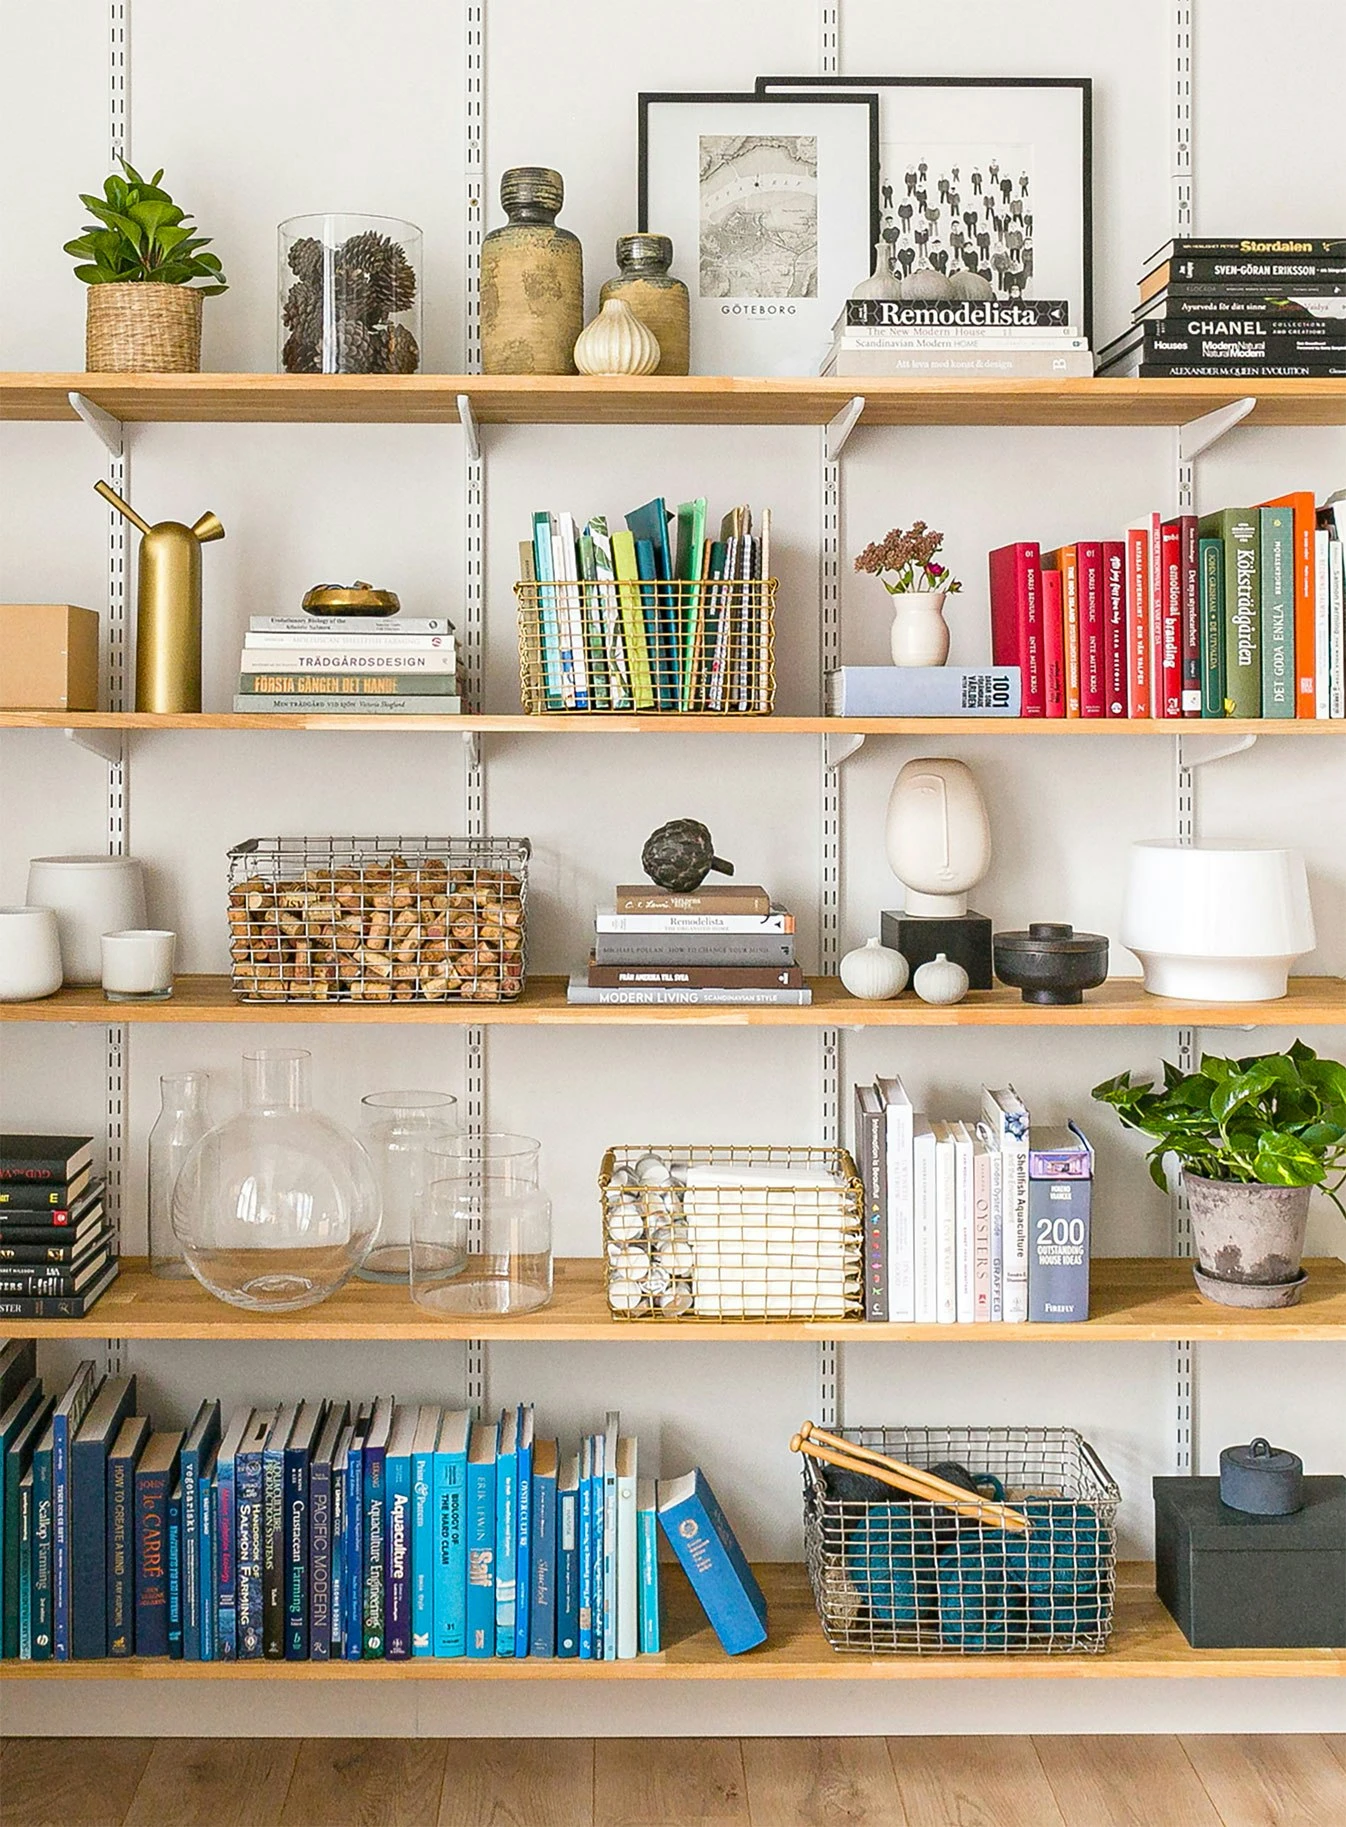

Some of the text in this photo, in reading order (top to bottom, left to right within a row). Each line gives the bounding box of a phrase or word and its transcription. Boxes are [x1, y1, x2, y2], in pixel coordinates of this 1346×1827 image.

[1240, 240, 1312, 253] Stordalen
[1214, 263, 1271, 275] SVEN-GÖRAN
[1273, 264, 1316, 275] ERIKSSON
[721, 303, 797, 315] GÖTEBORG
[880, 301, 1038, 326] Remodelista
[1181, 303, 1219, 312] Ayurveda
[1220, 302, 1232, 310] för
[867, 327, 987, 337] The New Modern House
[1187, 321, 1267, 335] CHANEL
[855, 339, 914, 349] Scandinavian
[916, 339, 952, 349] Modern
[1154, 340, 1188, 350] Houses
[896, 360, 911, 369] Att
[983, 360, 1013, 372] design
[1169, 366, 1310, 376] ALEXANDER EVOLUTION
[1188, 569, 1197, 583] Det
[1208, 554, 1216, 576] JOHN
[1187, 584, 1196, 597] nya
[1332, 570, 1342, 635] Salmon Farming
[1163, 564, 1180, 669] emotional branding
[1231, 548, 1257, 667] Köksträdgården
[1272, 603, 1284, 641] ENKLA
[1209, 621, 1217, 633] DE
[1029, 636, 1037, 654] INTE
[1209, 633, 1217, 671] UTVALDA
[298, 655, 426, 667] TRÄDGÅRDSDESIGN
[1090, 654, 1098, 674] MITT
[1273, 645, 1285, 676] GODA
[254, 675, 359, 694] FÖRSTA GÅNGEN DET
[993, 675, 1010, 708] 1001
[1030, 675, 1038, 695] KRIG
[1090, 675, 1098, 694] KRIG
[1273, 680, 1285, 703] DET
[599, 992, 778, 1003] MODERN LIVING SCANDINAVIAN STYLE
[871, 1118, 881, 1199] Information Beautiful
[1016, 1153, 1027, 1196] Shellfish
[976, 1198, 989, 1280] OYSTERS
[992, 1157, 1001, 1313] London Oyster Guide GRAFFEG
[1014, 1198, 1026, 1258] Aquaculture
[1036, 1218, 1084, 1245] 200
[1036, 1245, 1084, 1255] OUTSTANDING
[1039, 1255, 1083, 1266] HOUSE IDEAS
[114, 1464, 124, 1488] HOW
[115, 1489, 124, 1503] TO
[142, 1493, 162, 1510] le
[185, 1463, 197, 1533] vegetariskt
[273, 1460, 282, 1532] AQUACULTURE
[414, 1460, 429, 1527] Print & Pattern
[114, 1504, 124, 1542] CREATE
[265, 1460, 274, 1571] PRODUCTION SYSTEMS
[451, 1493, 460, 1545] BIOLOGY OF
[476, 1476, 486, 1541] ERIK LEWIN
[520, 1480, 529, 1546] OYSTER CULTURE
[252, 1503, 261, 1578] HANDBOOK OF
[390, 1494, 409, 1579] Aquaculture
[441, 1493, 450, 1565] THE HARD CLAM
[35, 1501, 51, 1591] Scallop Farming
[142, 1512, 165, 1578] CARRÉ
[289, 1499, 305, 1613] Crustacean Farming
[366, 1462, 383, 1629] LEKANG Aquaculture Engineering
[115, 1550, 124, 1576] MIND
[221, 1553, 231, 1582] Ecology
[240, 1504, 252, 1626] SALMON FARMING
[313, 1494, 328, 1627] PACIFIC MODERN
[537, 1558, 548, 1606] Shucked
